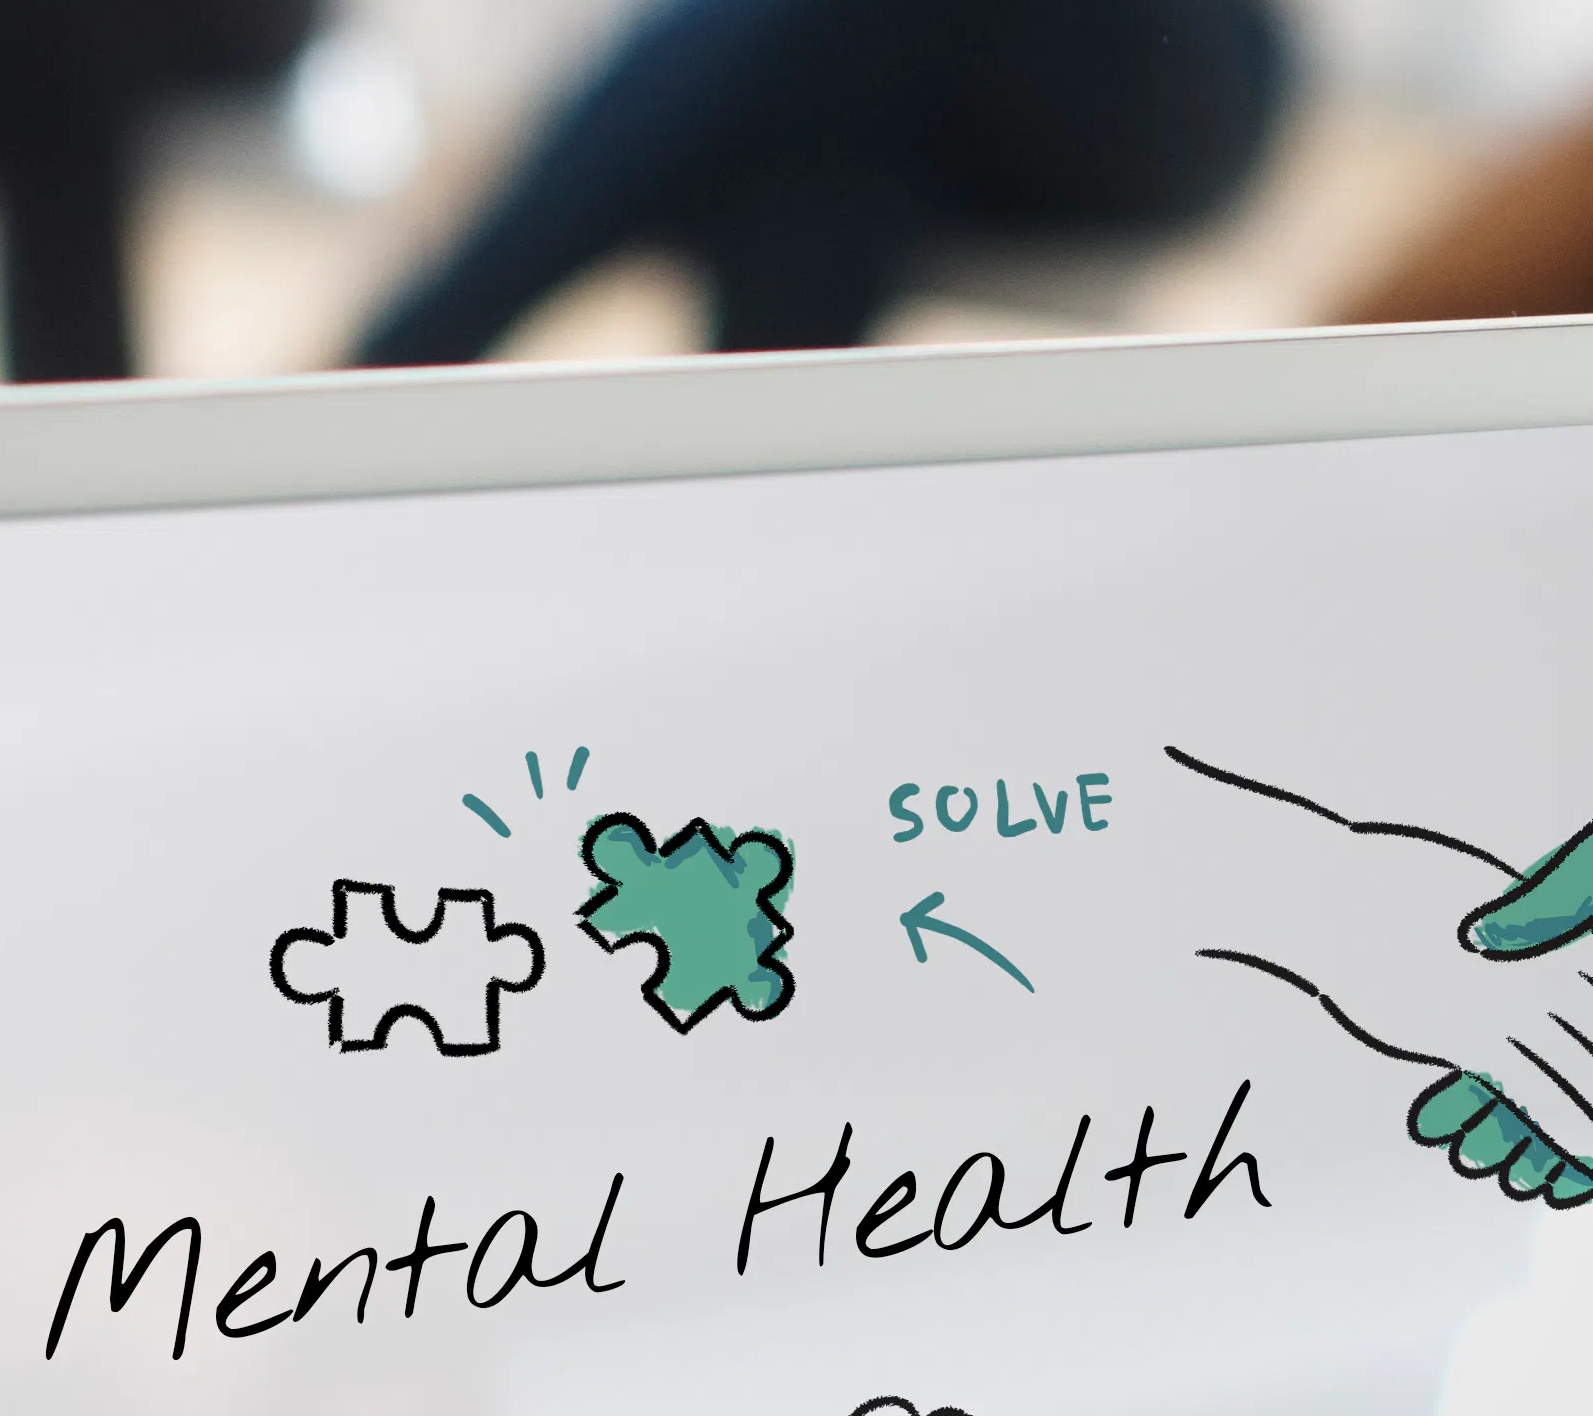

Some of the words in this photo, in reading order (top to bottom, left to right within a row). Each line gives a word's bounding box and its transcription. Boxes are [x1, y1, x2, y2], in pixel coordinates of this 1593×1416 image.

[888, 772, 1113, 844] SOLVE
[45, 1171, 626, 1361] Mental
[736, 1078, 1273, 1277] Health
